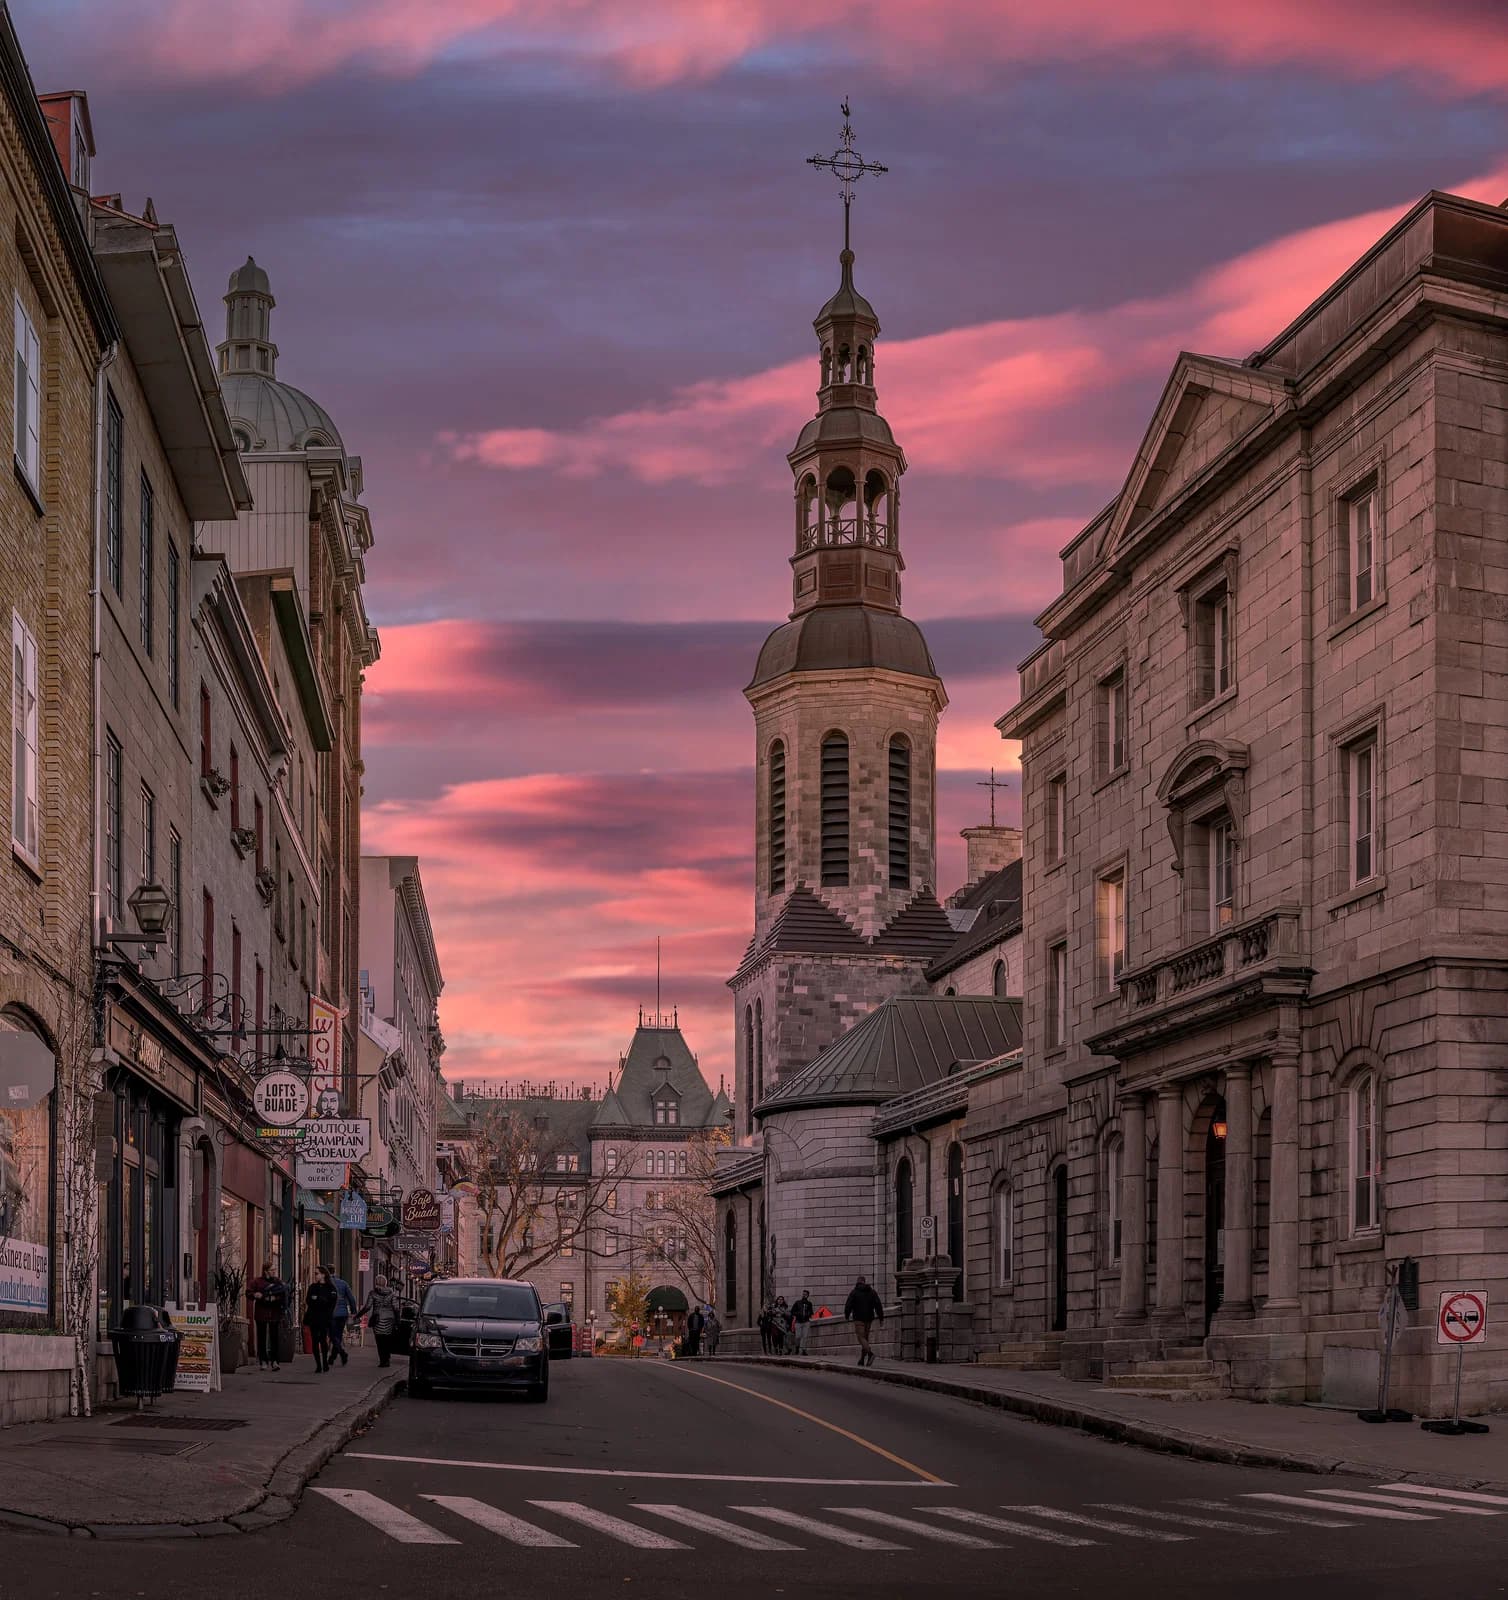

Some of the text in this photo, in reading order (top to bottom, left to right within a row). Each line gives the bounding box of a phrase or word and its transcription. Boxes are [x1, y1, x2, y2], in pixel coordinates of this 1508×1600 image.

[266, 1083, 296, 1097] LOFTS
[264, 1098, 298, 1112] BUADE
[261, 1128, 301, 1137] SUBWAY
[304, 1123, 361, 1136] BOUTIQUE
[307, 1147, 357, 1159] CADEAUX
[410, 1192, 432, 1210] Café
[405, 1207, 439, 1221] Buade
[397, 1238, 426, 1249] bizou
[32, 1247, 47, 1279] ligne
